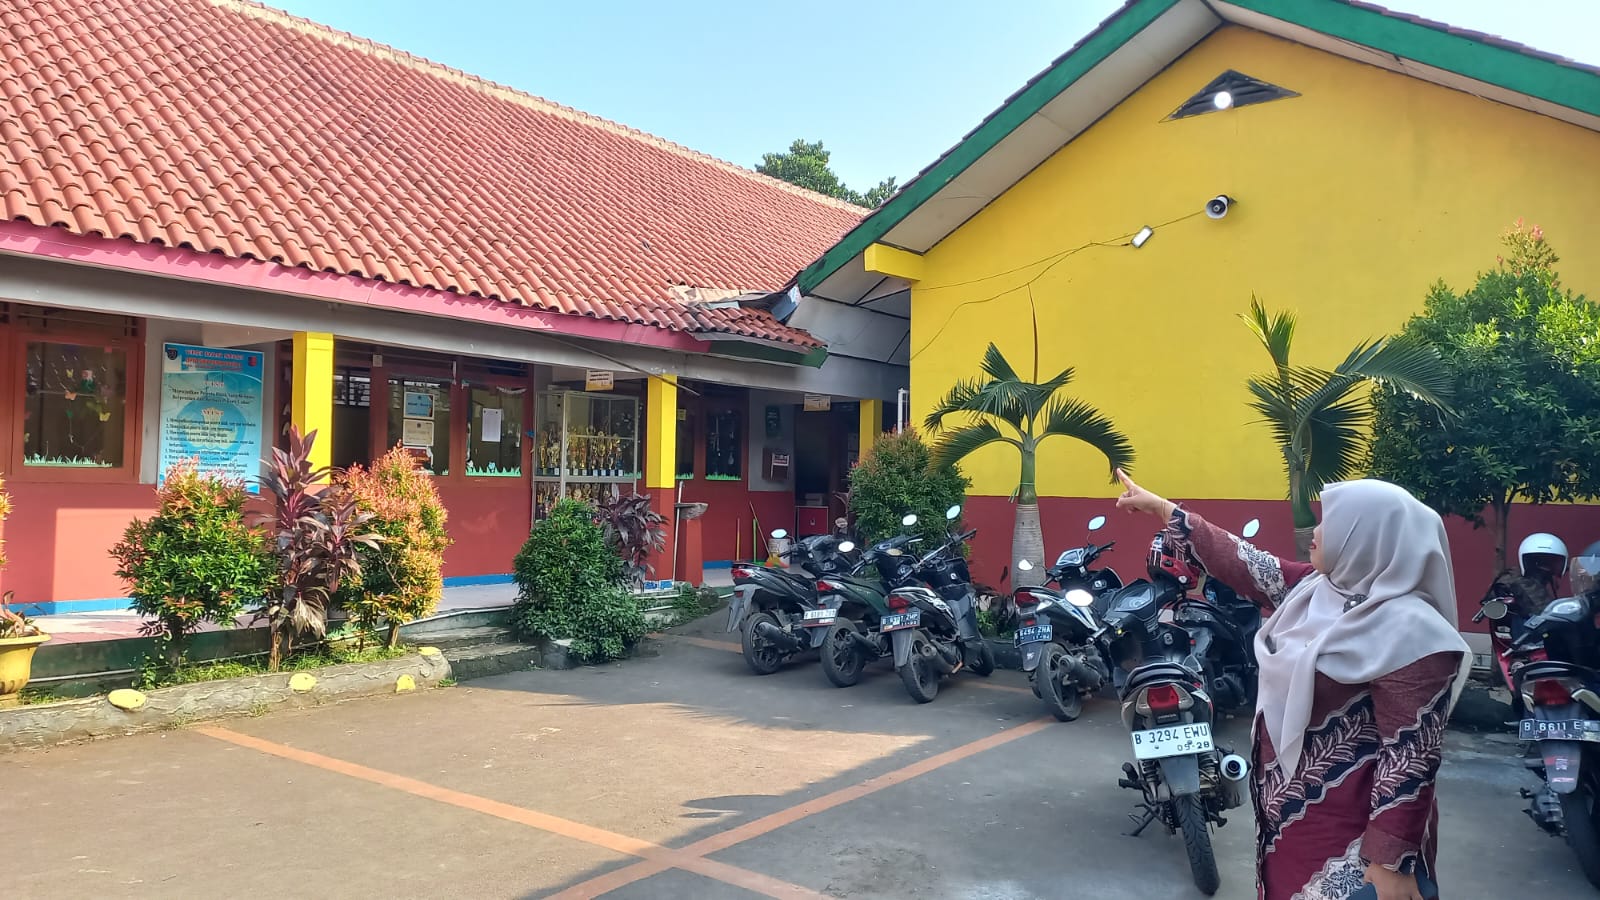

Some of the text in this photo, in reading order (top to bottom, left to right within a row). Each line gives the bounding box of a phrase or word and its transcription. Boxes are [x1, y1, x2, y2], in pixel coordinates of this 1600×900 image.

[1524, 722, 1531, 731] B
[1134, 725, 1208, 745] B 3294 EWU
